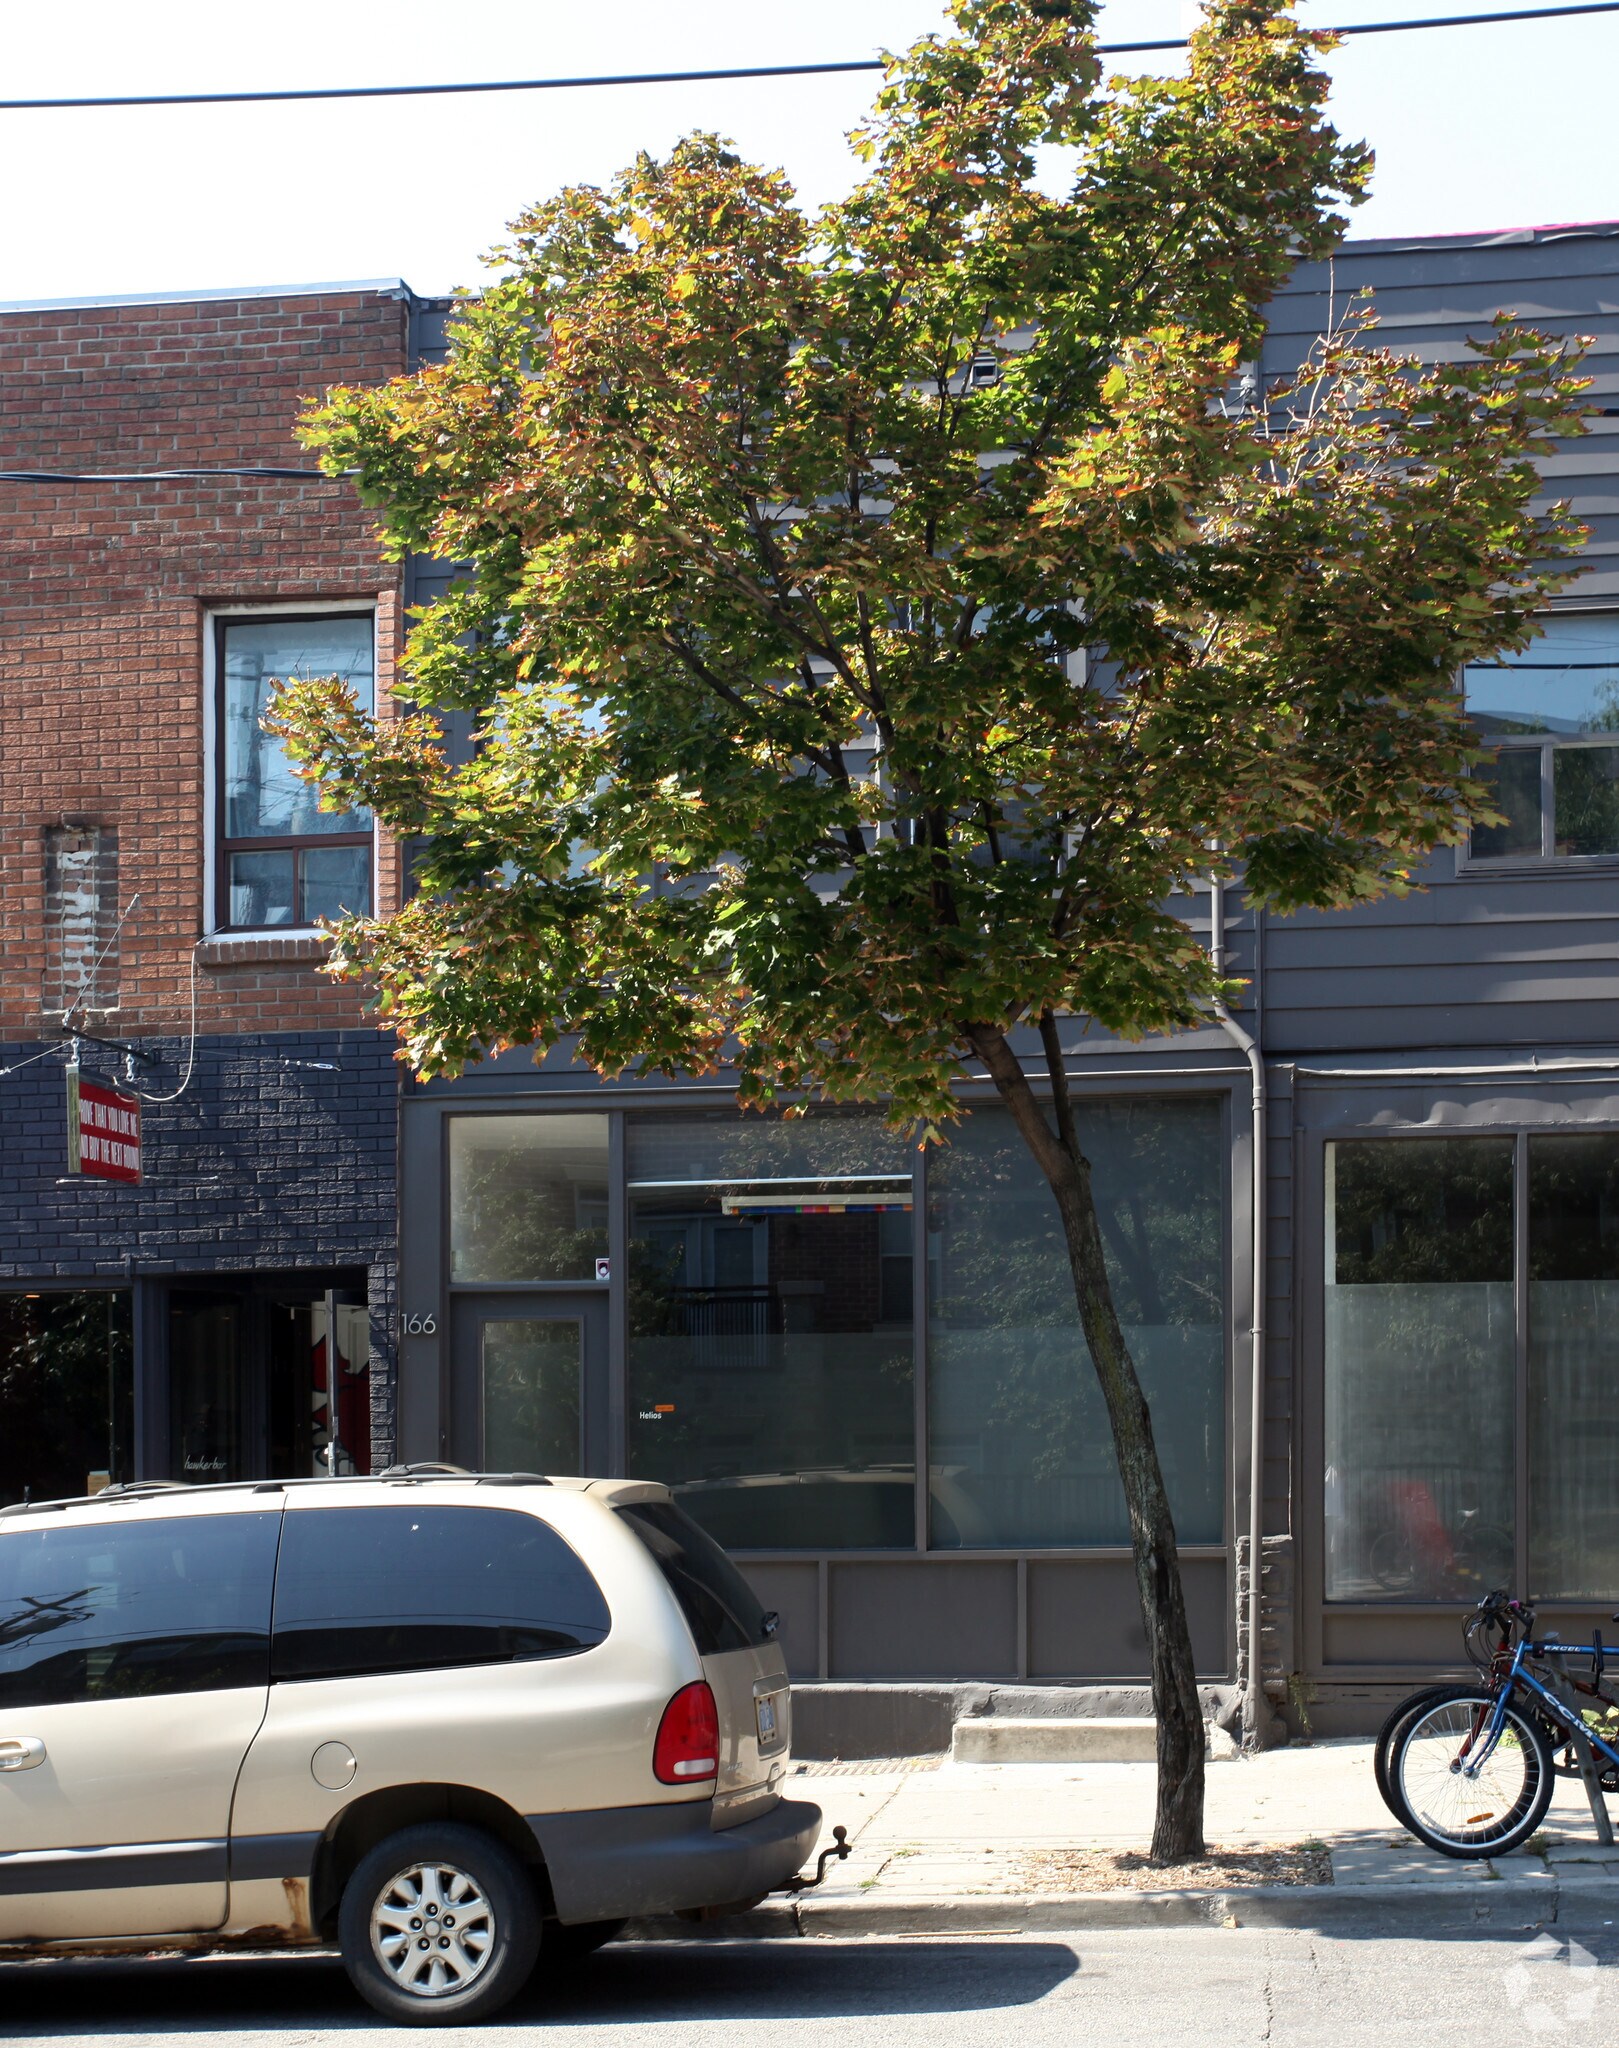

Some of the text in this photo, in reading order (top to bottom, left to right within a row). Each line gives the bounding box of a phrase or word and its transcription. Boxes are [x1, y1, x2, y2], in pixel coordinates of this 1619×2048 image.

[95, 1102, 107, 1129] THAT
[108, 1106, 118, 1132] YOU
[118, 1109, 130, 1135] LOVE
[130, 1112, 138, 1138] ME
[89, 1135, 100, 1161] BUY
[101, 1138, 110, 1164] THE
[111, 1141, 123, 1167] NEXT
[123, 1144, 139, 1170] ROUND
[401, 1313, 436, 1335] 166
[639, 1411, 662, 1420] Helios
[184, 1454, 227, 1470] hawkerbar
[1543, 1691, 1594, 1738] CCM
